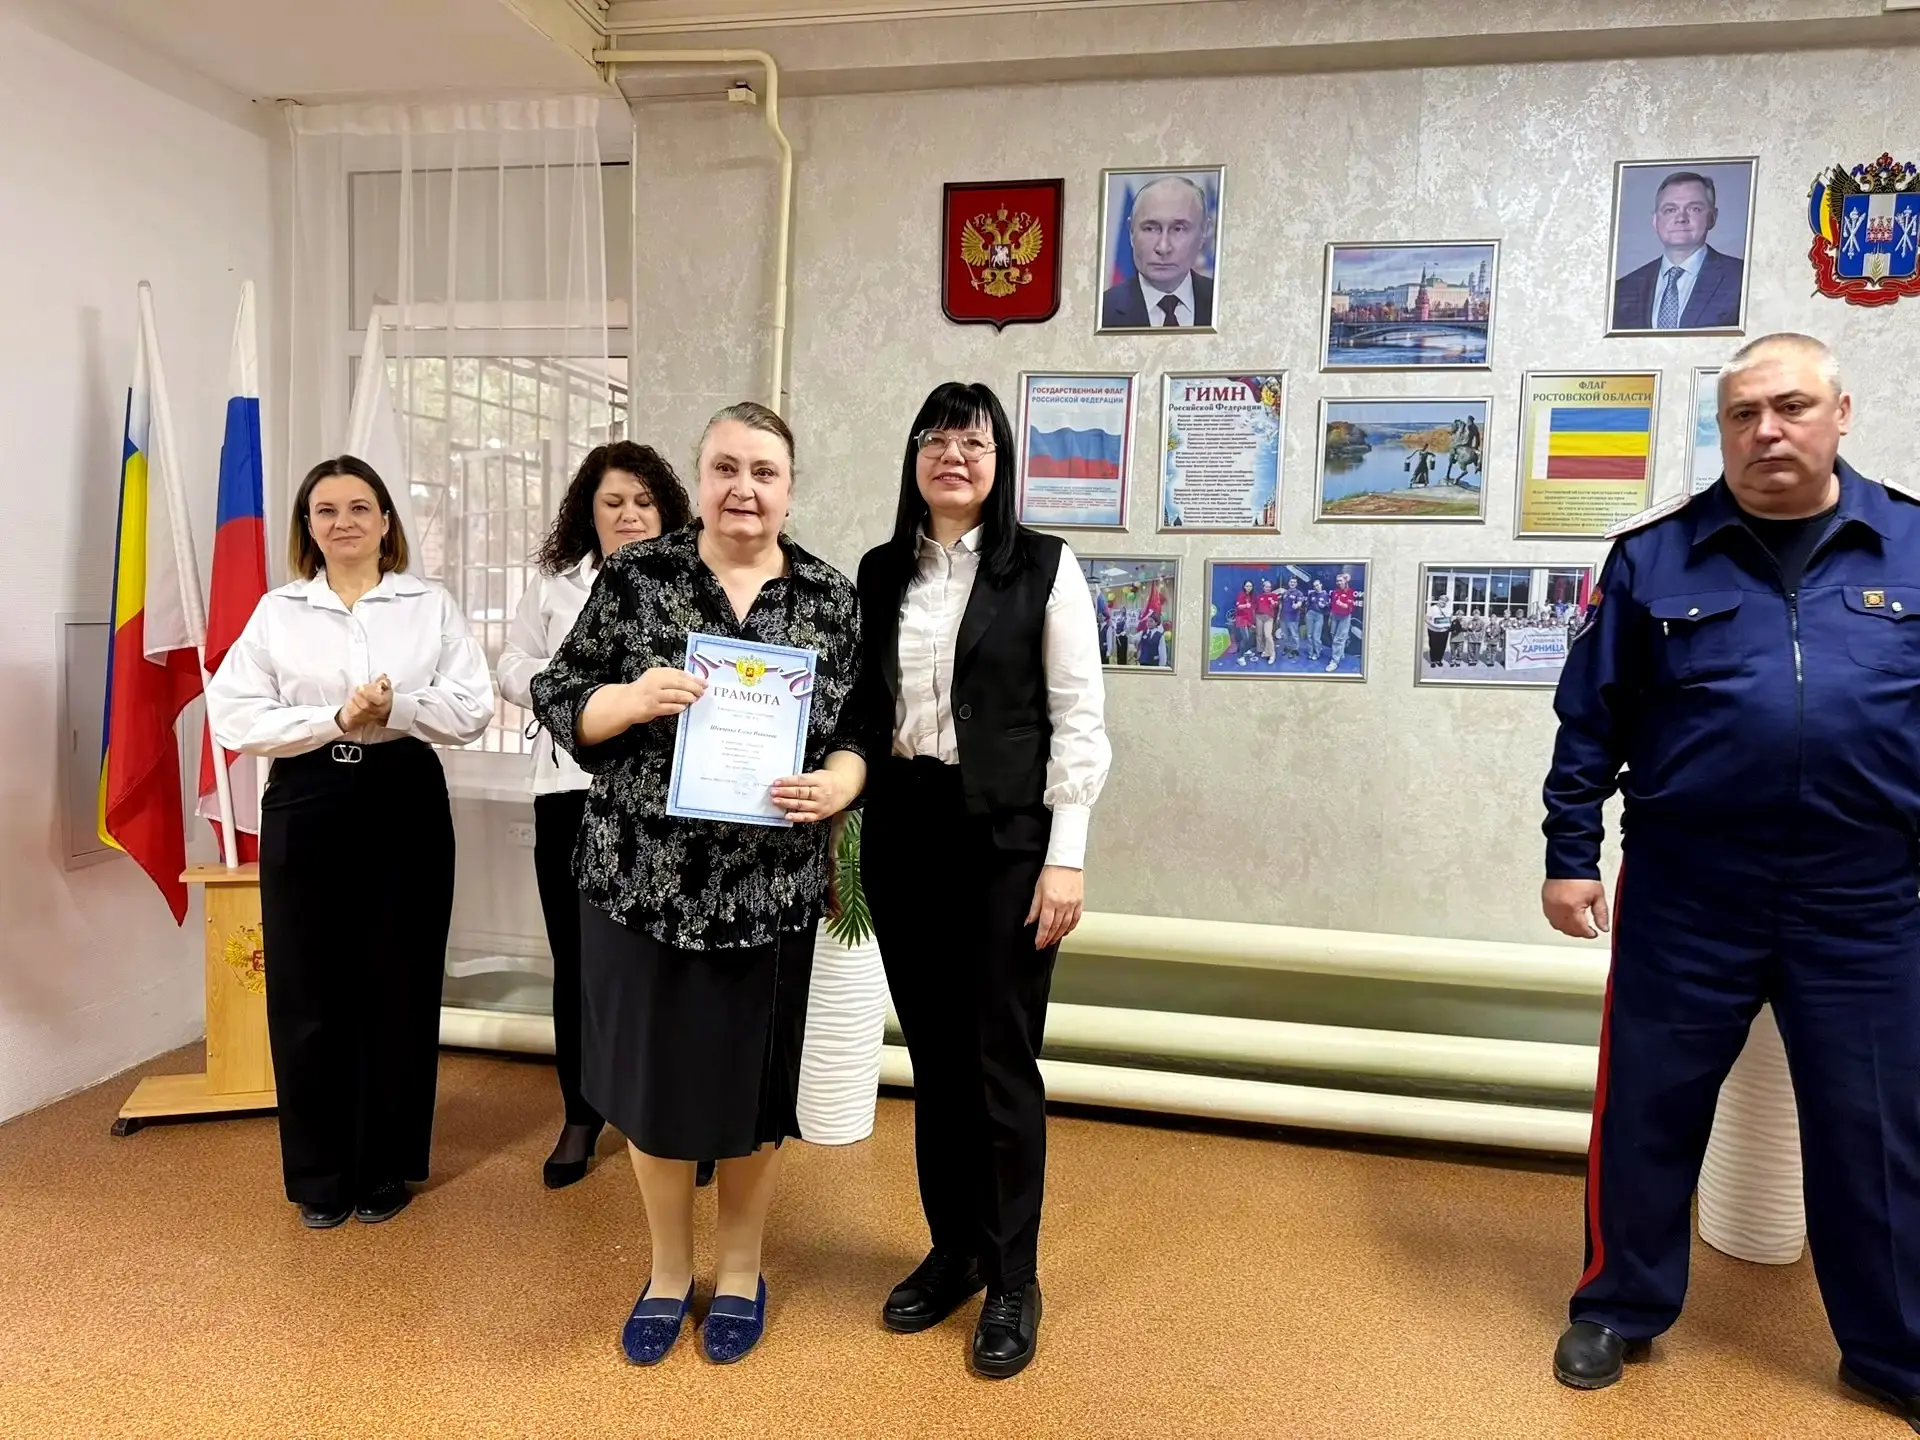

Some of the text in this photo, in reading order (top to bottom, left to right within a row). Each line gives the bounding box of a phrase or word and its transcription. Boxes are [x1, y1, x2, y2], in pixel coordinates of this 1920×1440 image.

[1578, 381, 1607, 389] ФЛАГ
[1032, 387, 1124, 395] ГОСУДАРСТВЕННЫЙ ФЛАГ
[1184, 386, 1246, 401] ГИМН
[1032, 396, 1124, 404] РОССИЙСКОЙ ФЕДЕРАЦИИ
[1533, 391, 1652, 401] РОСТОВСКОЙ ОБЛАСТИ
[1169, 403, 1262, 412] Российской Федерации
[713, 686, 781, 706] ГРАМОТА
